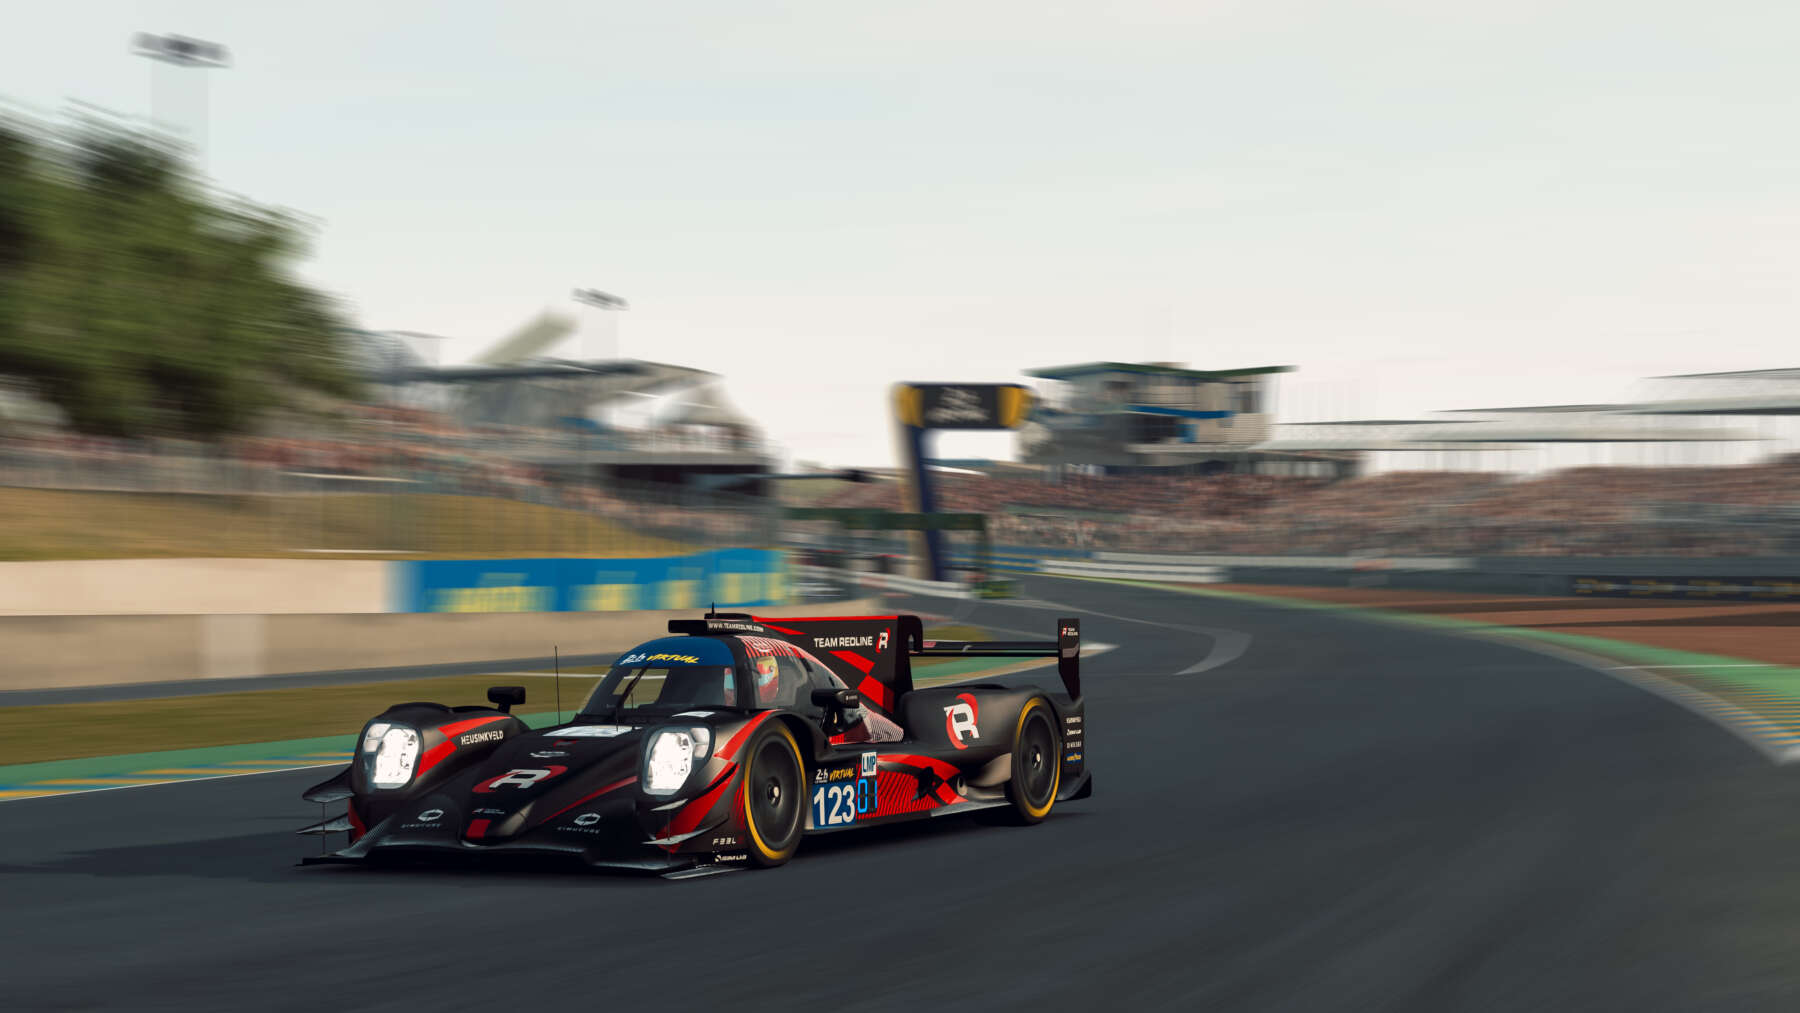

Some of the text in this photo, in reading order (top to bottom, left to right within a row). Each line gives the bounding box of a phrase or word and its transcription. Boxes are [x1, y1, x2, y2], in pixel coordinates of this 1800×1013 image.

[814, 636, 873, 648] TEAM REDLINE
[646, 653, 700, 664] VIRTUAL
[460, 730, 504, 745] HEUSINKVELD
[862, 755, 876, 773] LMP
[829, 768, 855, 782] VIRTUAL
[857, 778, 878, 814] 01
[813, 784, 856, 826] 123
